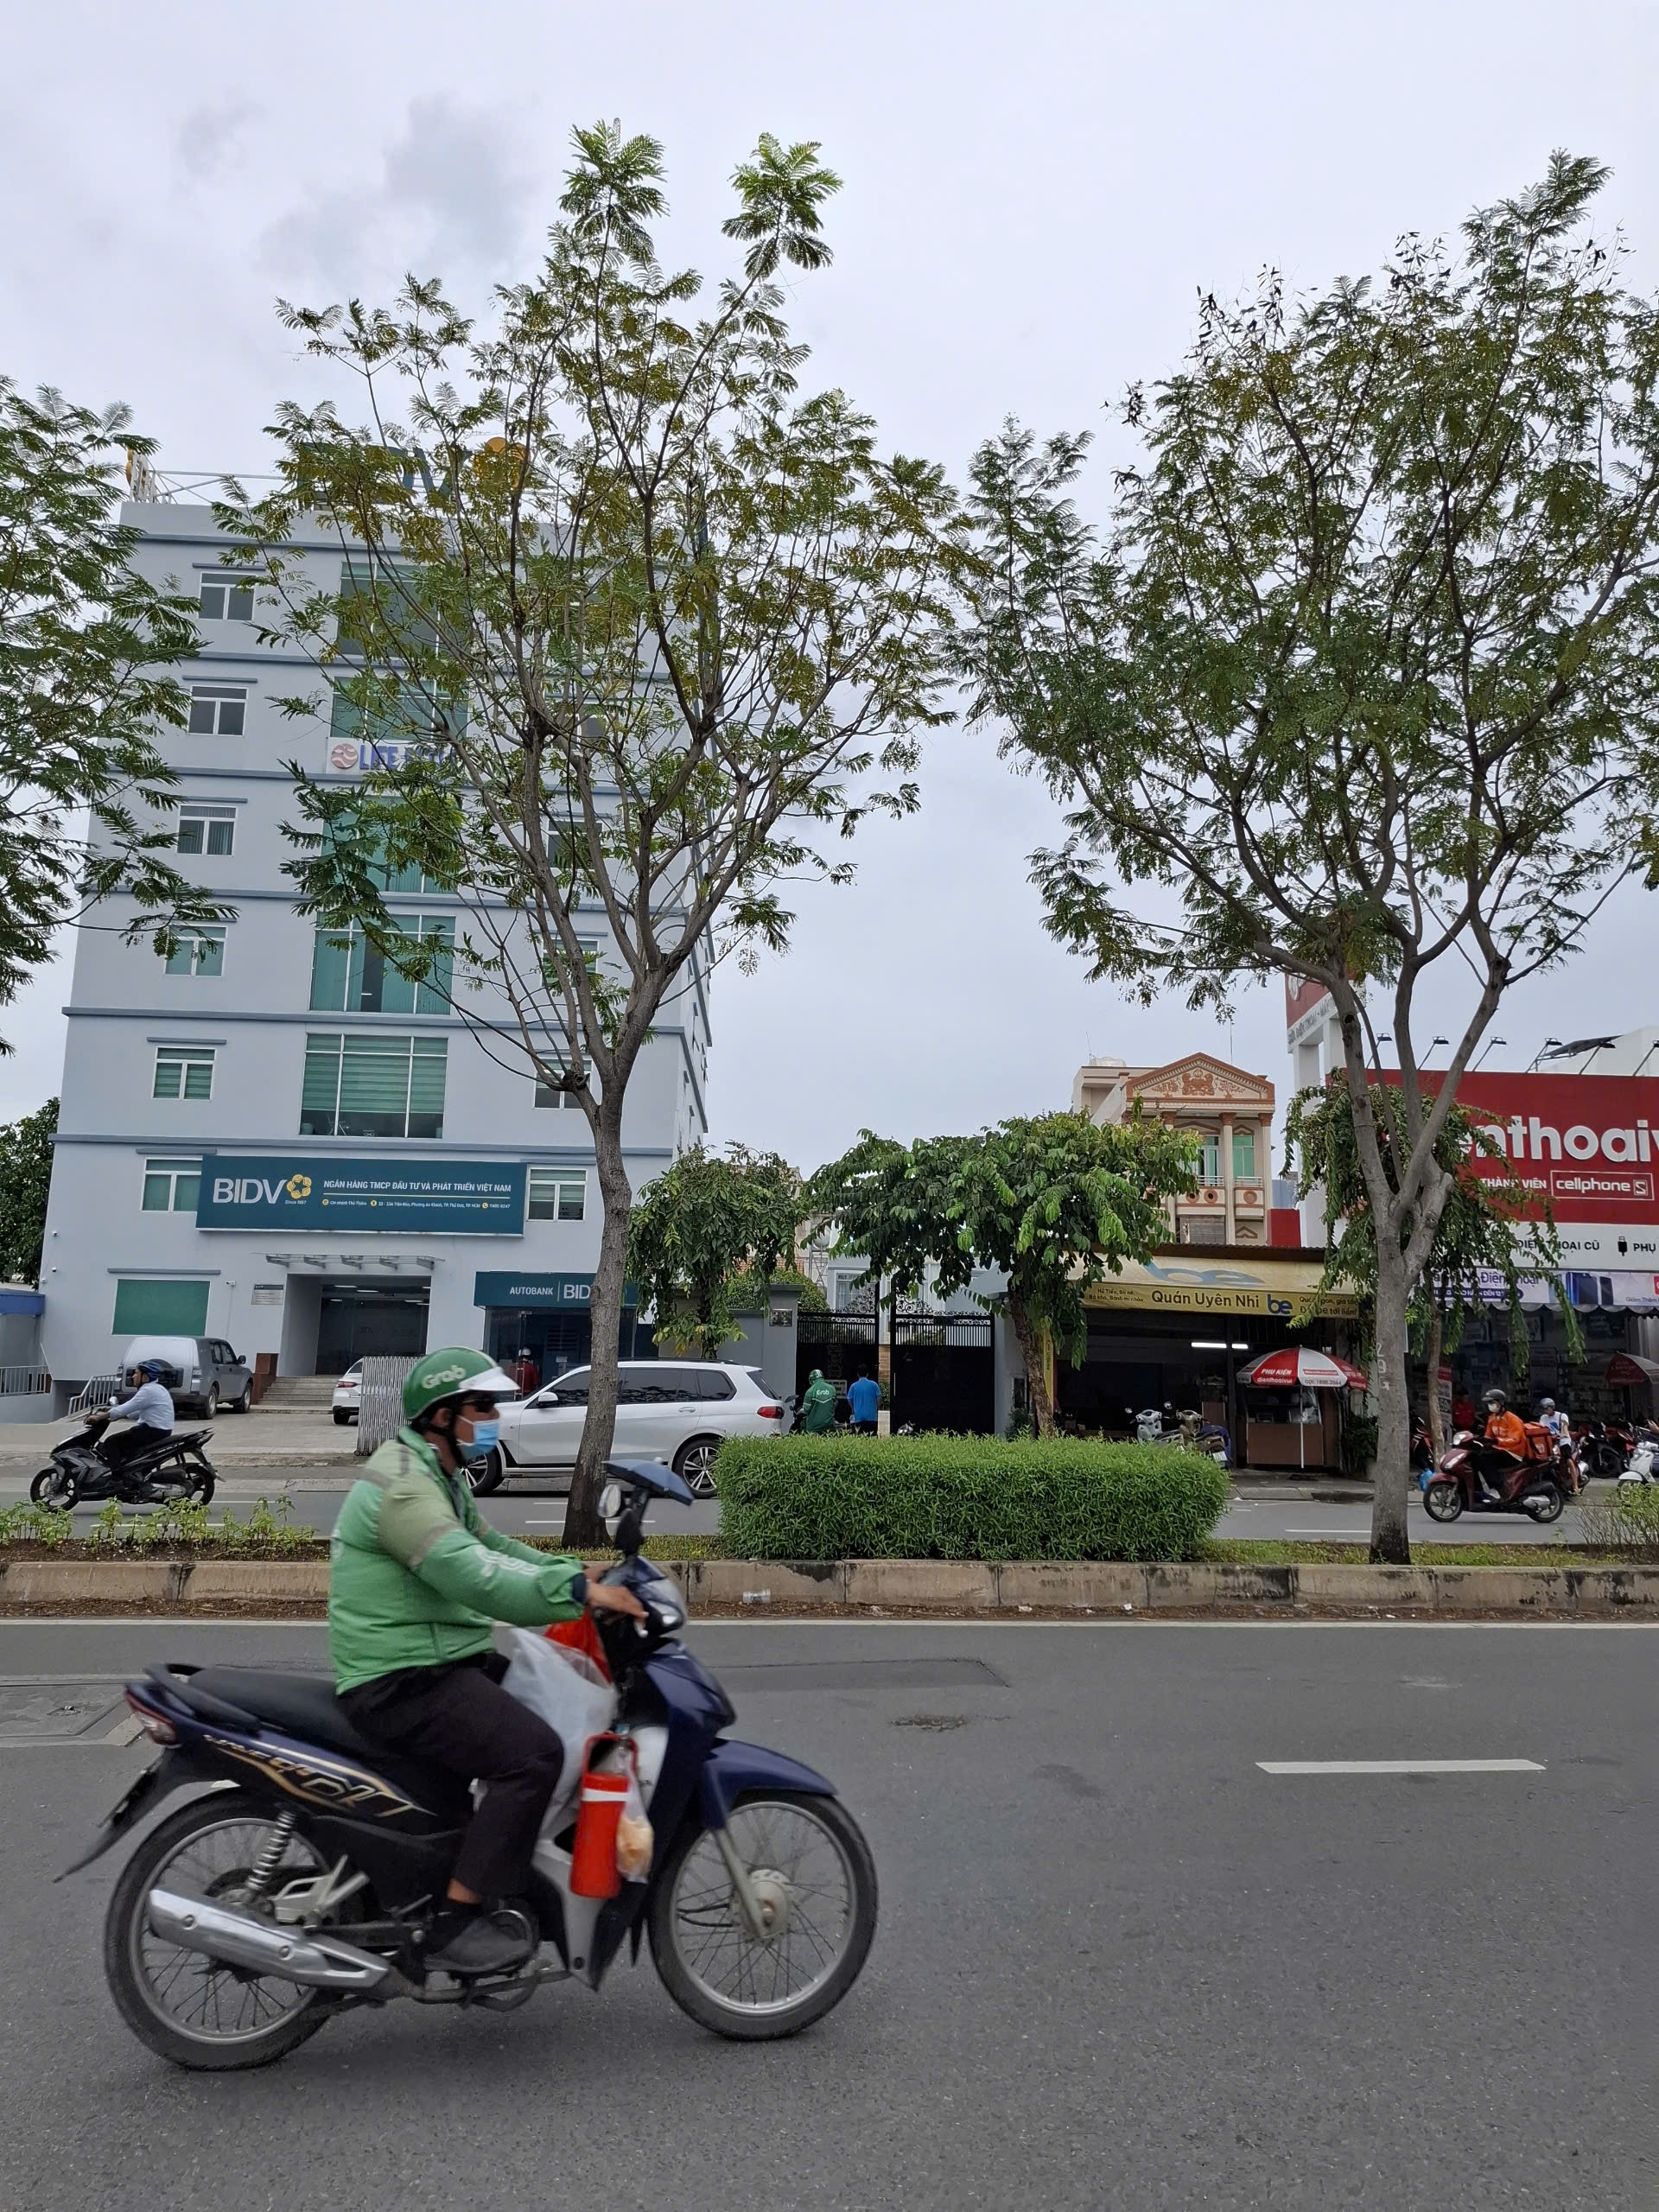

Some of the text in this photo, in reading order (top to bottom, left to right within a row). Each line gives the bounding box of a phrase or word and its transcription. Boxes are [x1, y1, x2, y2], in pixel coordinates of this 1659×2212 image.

[1458, 1116, 1659, 1162] nthoai
[323, 1179, 346, 1189] NGÂN
[346, 1179, 368, 1189] HÀNG
[391, 1180, 408, 1190] ĐẦU
[409, 1181, 420, 1190] TƯ
[421, 1181, 431, 1191] VÀ
[432, 1181, 453, 1191] PHÁT
[454, 1181, 475, 1192] TRIỂN
[476, 1182, 493, 1192] VIỆT
[493, 1184, 512, 1192] NAM
[1522, 1177, 1547, 1189] VIÊN
[213, 1178, 288, 1204] BIDV
[1517, 1238, 1537, 1251] ĐIỆ
[1584, 1239, 1600, 1250] CŨ
[1632, 1243, 1656, 1254] PHỤ
[1519, 1274, 1539, 1287] hoại
[509, 1286, 554, 1295] AUTOBANK
[563, 1284, 591, 1300] BID
[1151, 1290, 1259, 1308] Quán Uyên Nhi
[1266, 1294, 1294, 1315] be
[422, 1363, 467, 1389] Grab
